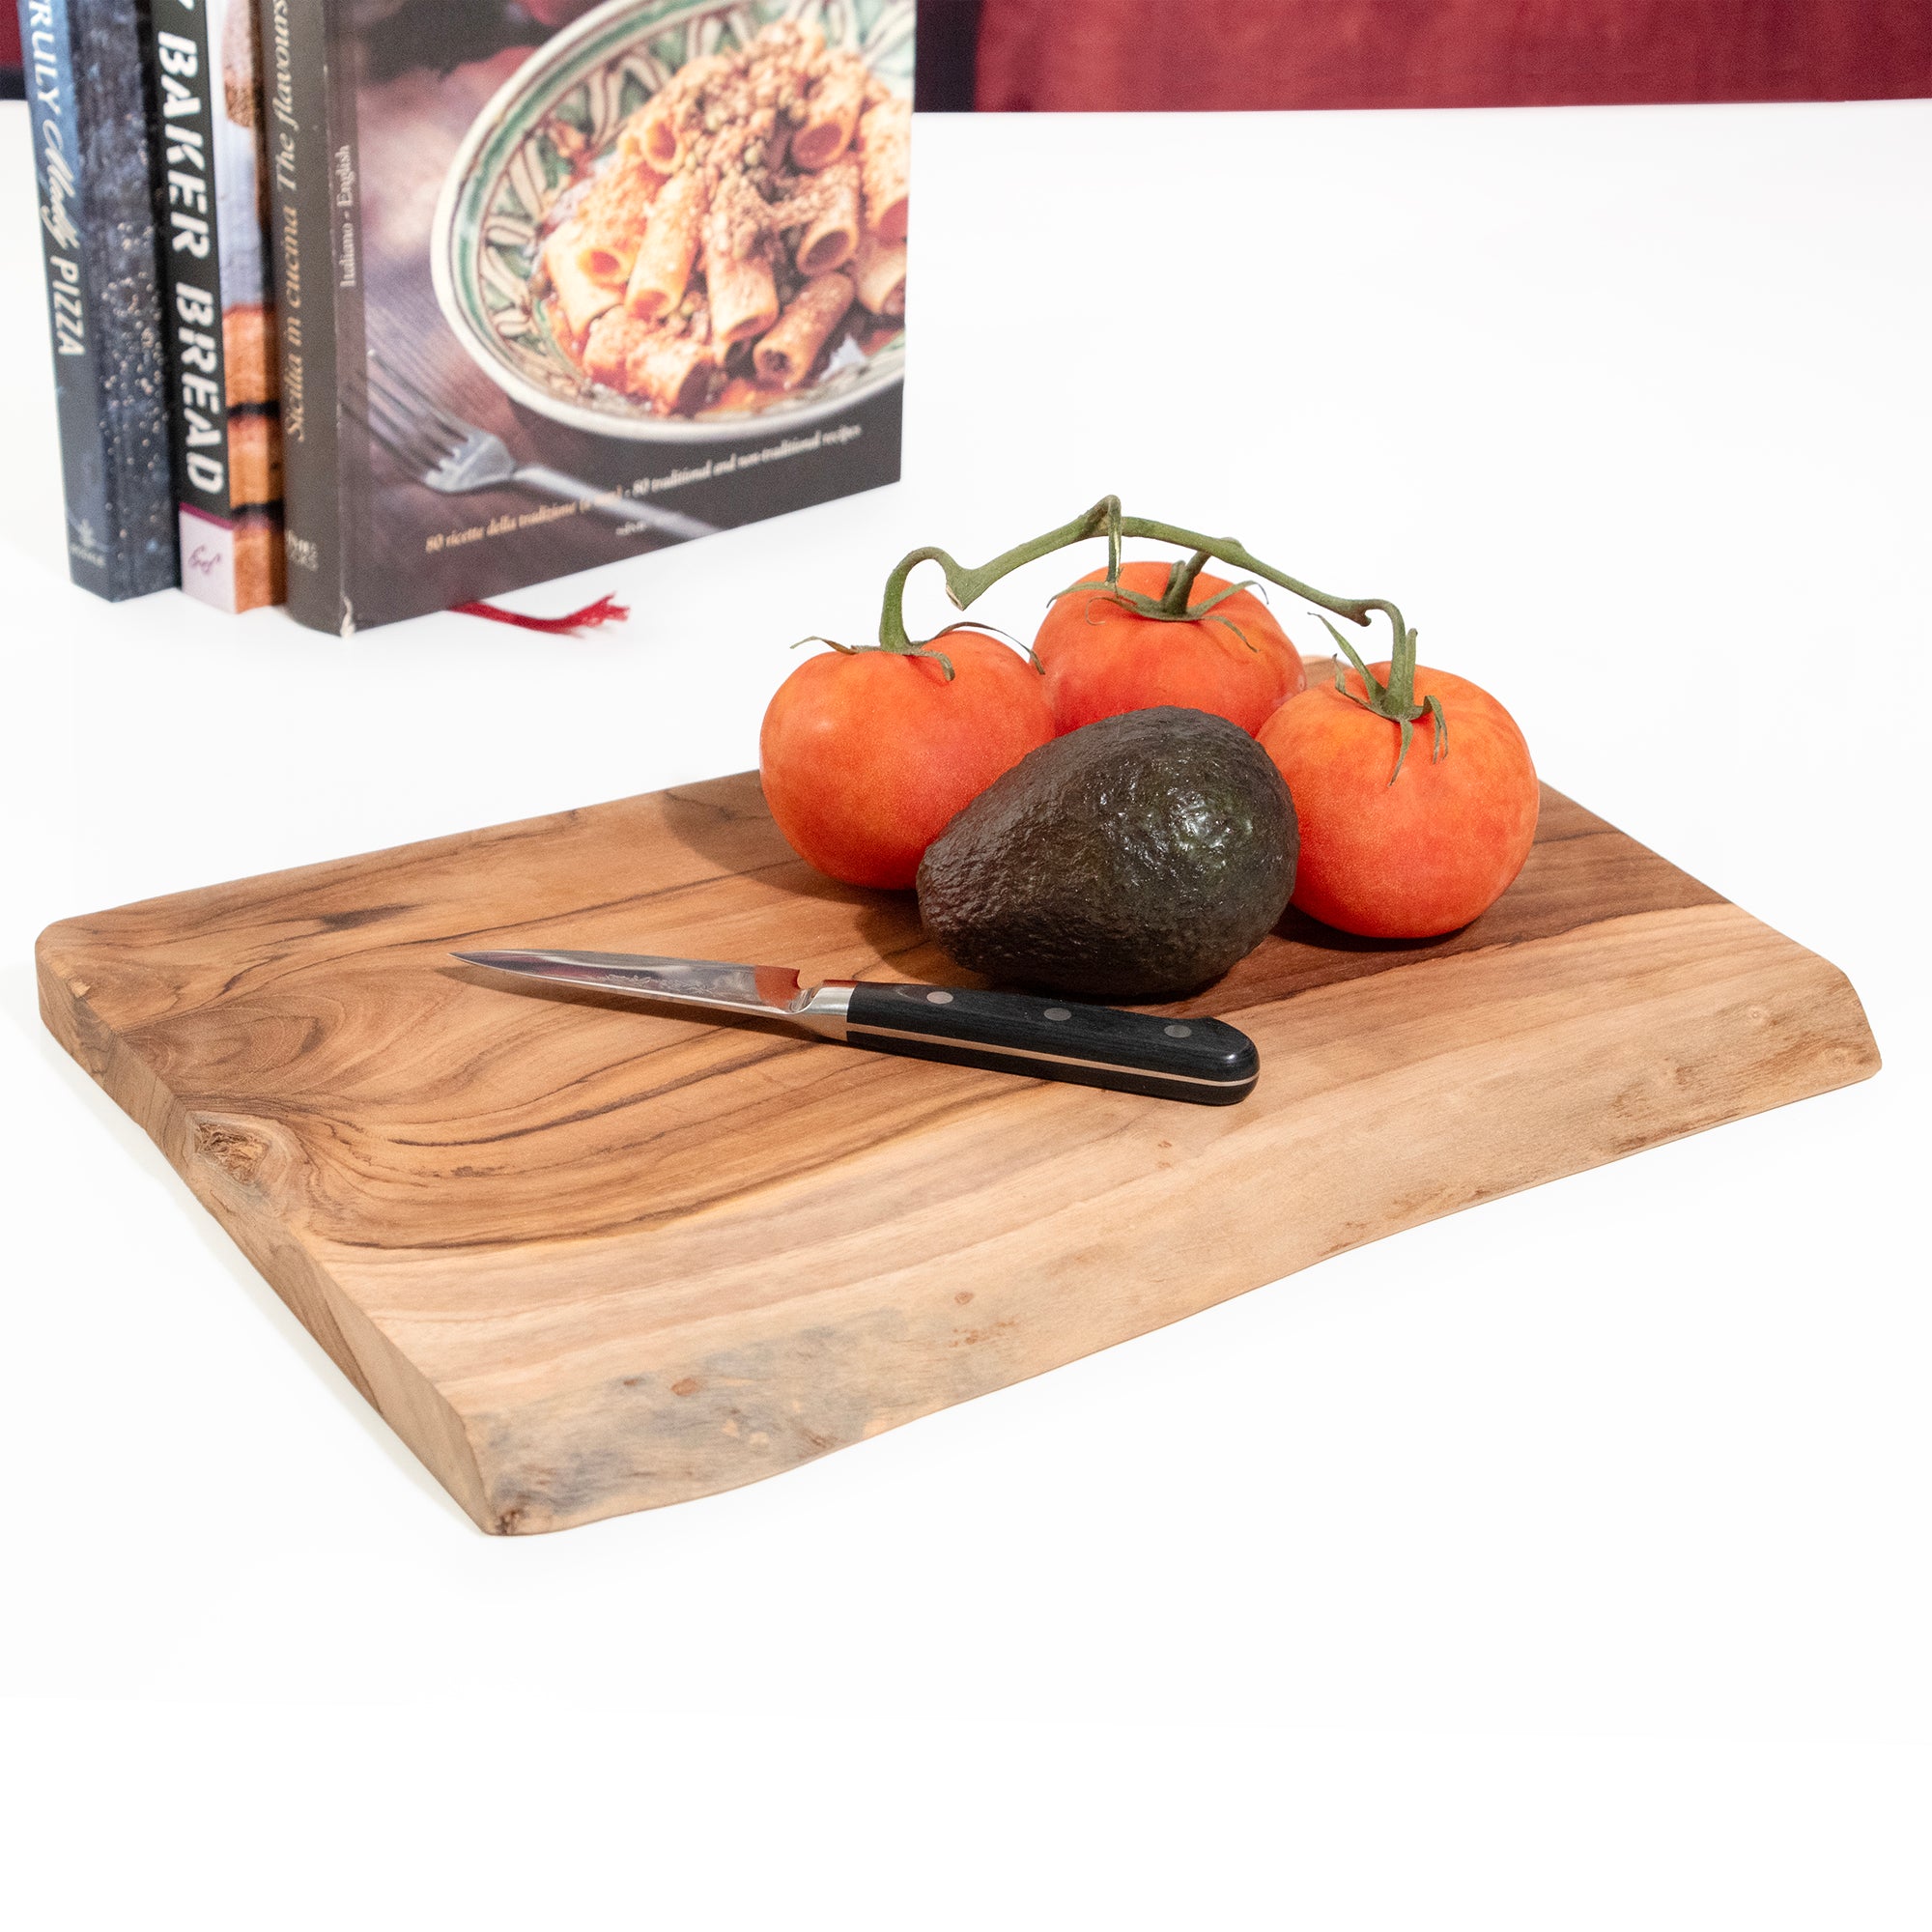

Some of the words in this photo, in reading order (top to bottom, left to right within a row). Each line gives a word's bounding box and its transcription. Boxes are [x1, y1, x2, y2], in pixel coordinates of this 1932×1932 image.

[272, 0, 299, 131] flavours
[28, 0, 62, 115] RULY
[50, 255, 85, 355] PIZZA
[157, 30, 211, 259] BAKER
[275, 132, 297, 191] The
[334, 144, 355, 207] English
[283, 205, 301, 308] cucina
[339, 222, 356, 287] Italiano
[286, 317, 302, 347] in
[176, 281, 225, 495] BREAD
[284, 353, 304, 442] Sicilia
